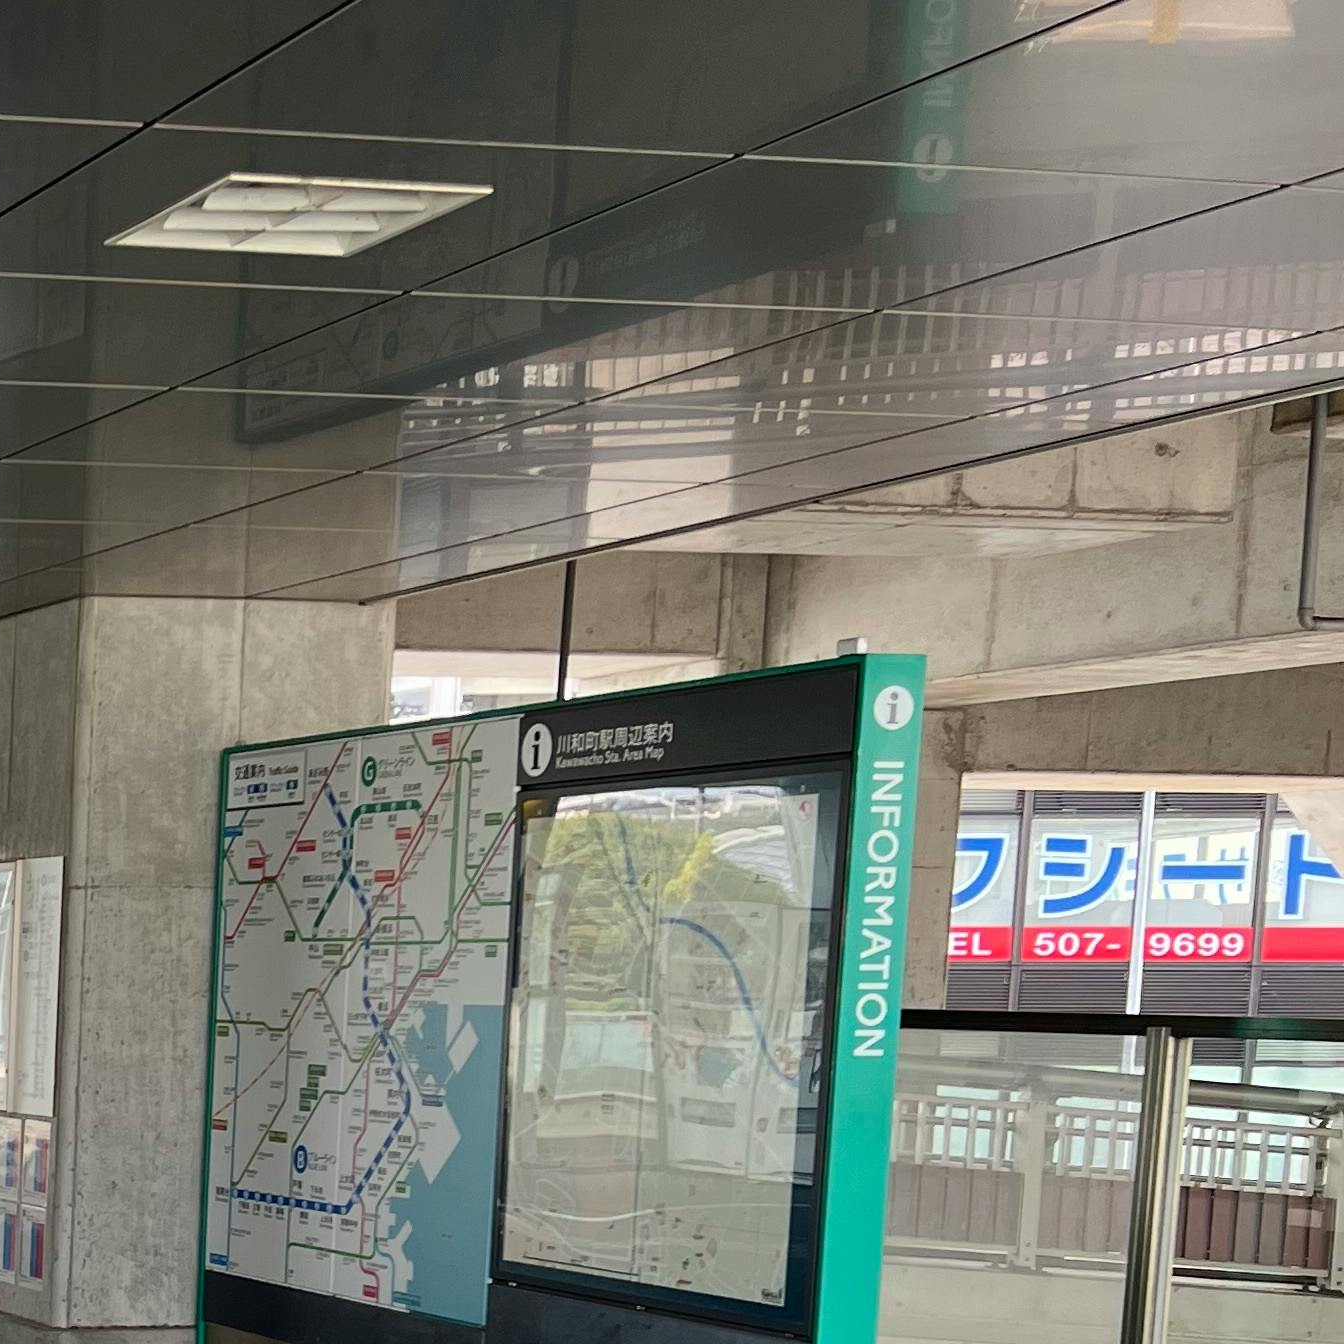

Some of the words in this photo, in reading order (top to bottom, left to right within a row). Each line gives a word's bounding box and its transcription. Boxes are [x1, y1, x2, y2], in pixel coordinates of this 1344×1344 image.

[556, 721, 674, 755] 川和町駅周辺案内
[605, 751, 621, 765] Sta.
[622, 748, 643, 762] Area
[644, 745, 665, 761] Map
[852, 761, 905, 1057] INFORMATION
